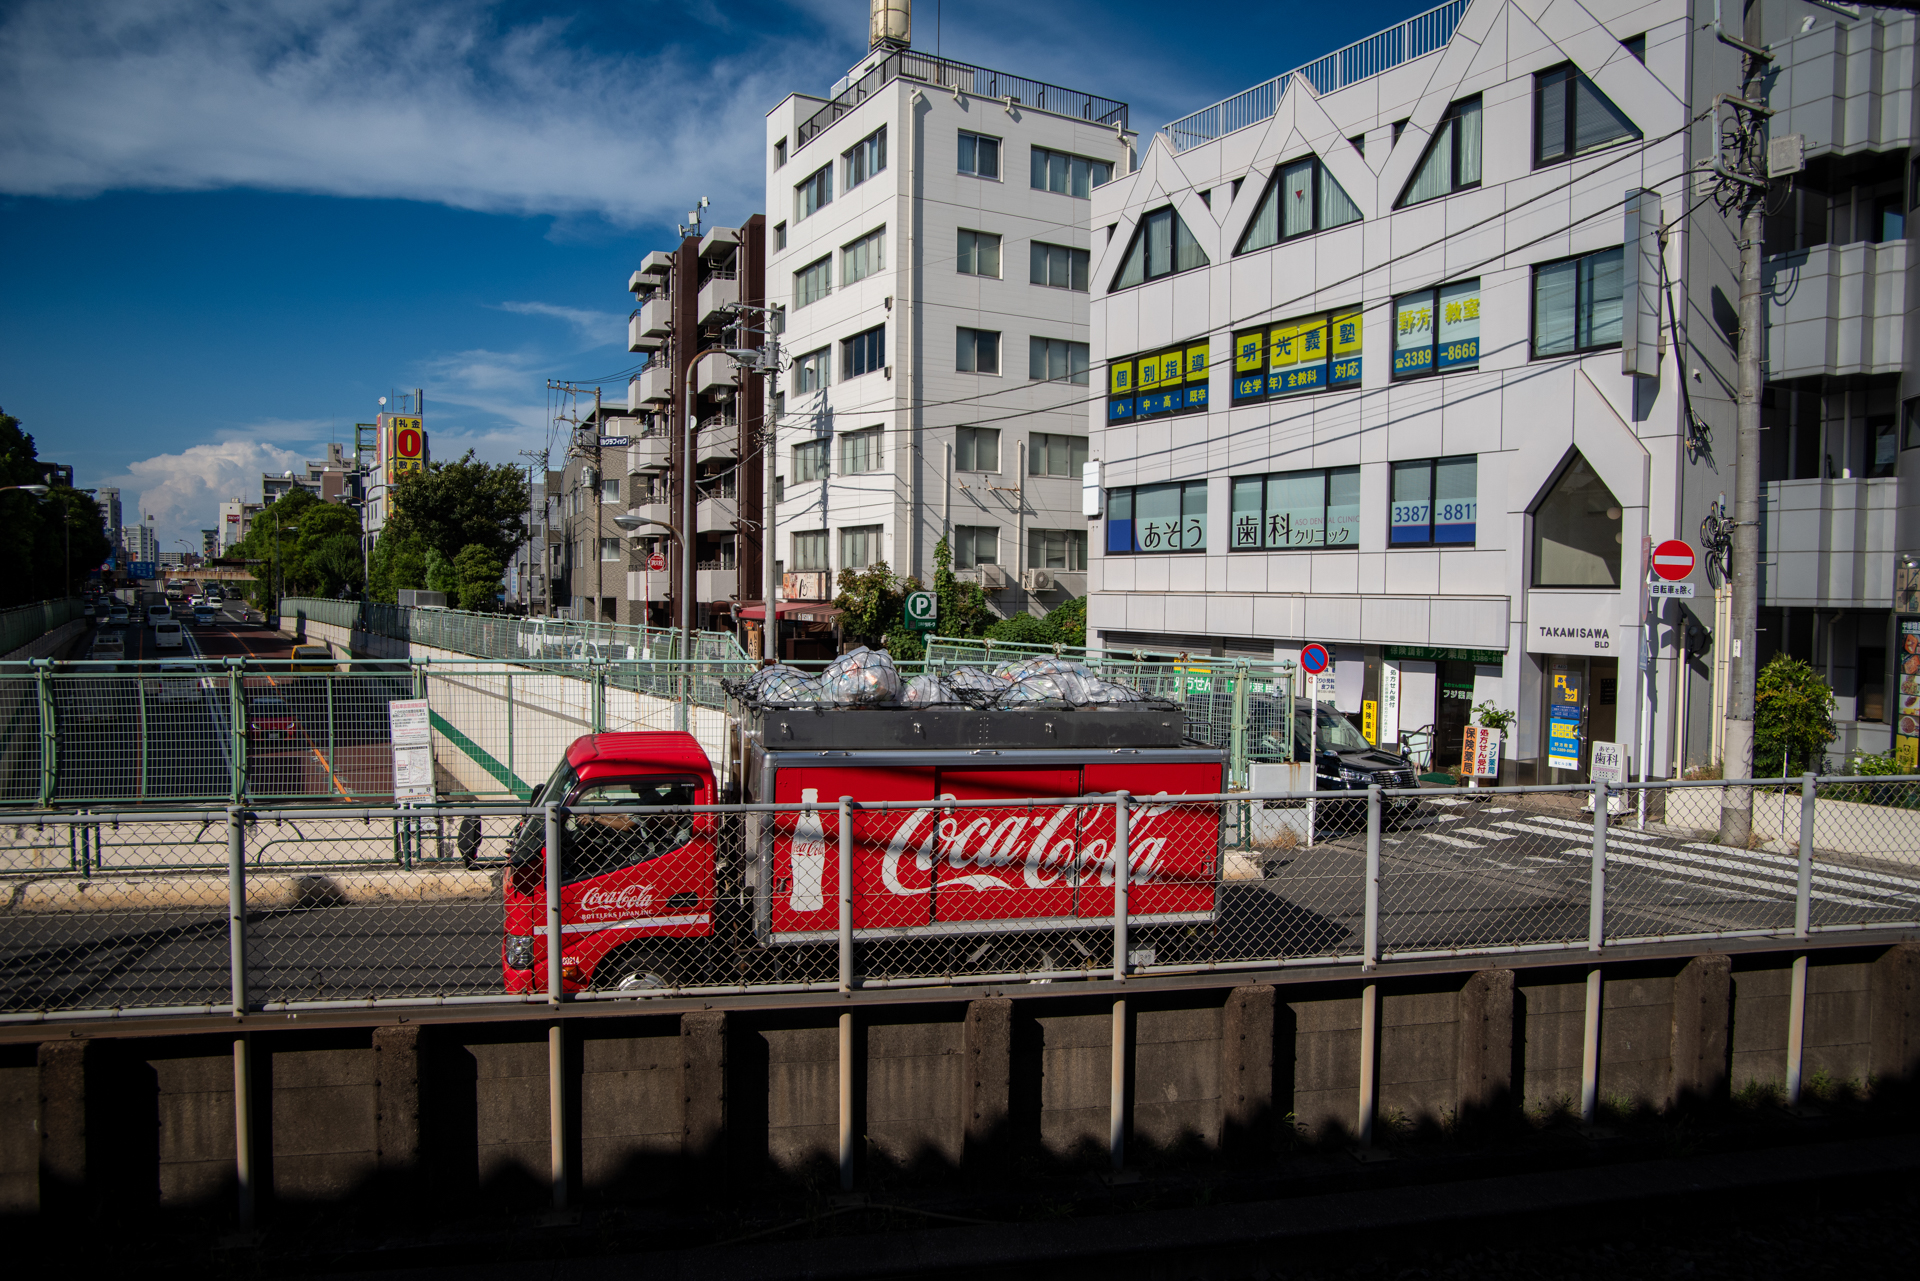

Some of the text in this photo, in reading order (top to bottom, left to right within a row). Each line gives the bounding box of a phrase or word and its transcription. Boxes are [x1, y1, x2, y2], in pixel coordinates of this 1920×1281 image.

[1243, 322, 1355, 363] 明光義塾
[1116, 353, 1204, 388] 個別指導
[398, 419, 420, 428] 礼金
[398, 429, 421, 457] 0
[1236, 513, 1293, 546] 歯科
[1309, 517, 1335, 525] DENAL
[1144, 519, 1202, 548] あそう
[1295, 527, 1349, 545] クリニック
[1652, 584, 1692, 595] 自転車を除く
[916, 597, 928, 615] P
[1539, 626, 1609, 639] TAKAMISAWA
[1428, 647, 1467, 660] フジ薬局
[1594, 641, 1609, 649] BLD
[1462, 727, 1497, 774] 保険薬局 処方せん受付 フジ薬局
[1595, 753, 1618, 766] 歯科
[881, 789, 1187, 896] Coca-Cola
[580, 883, 657, 911] Coca-Cola
[618, 910, 639, 918] JAPAN
